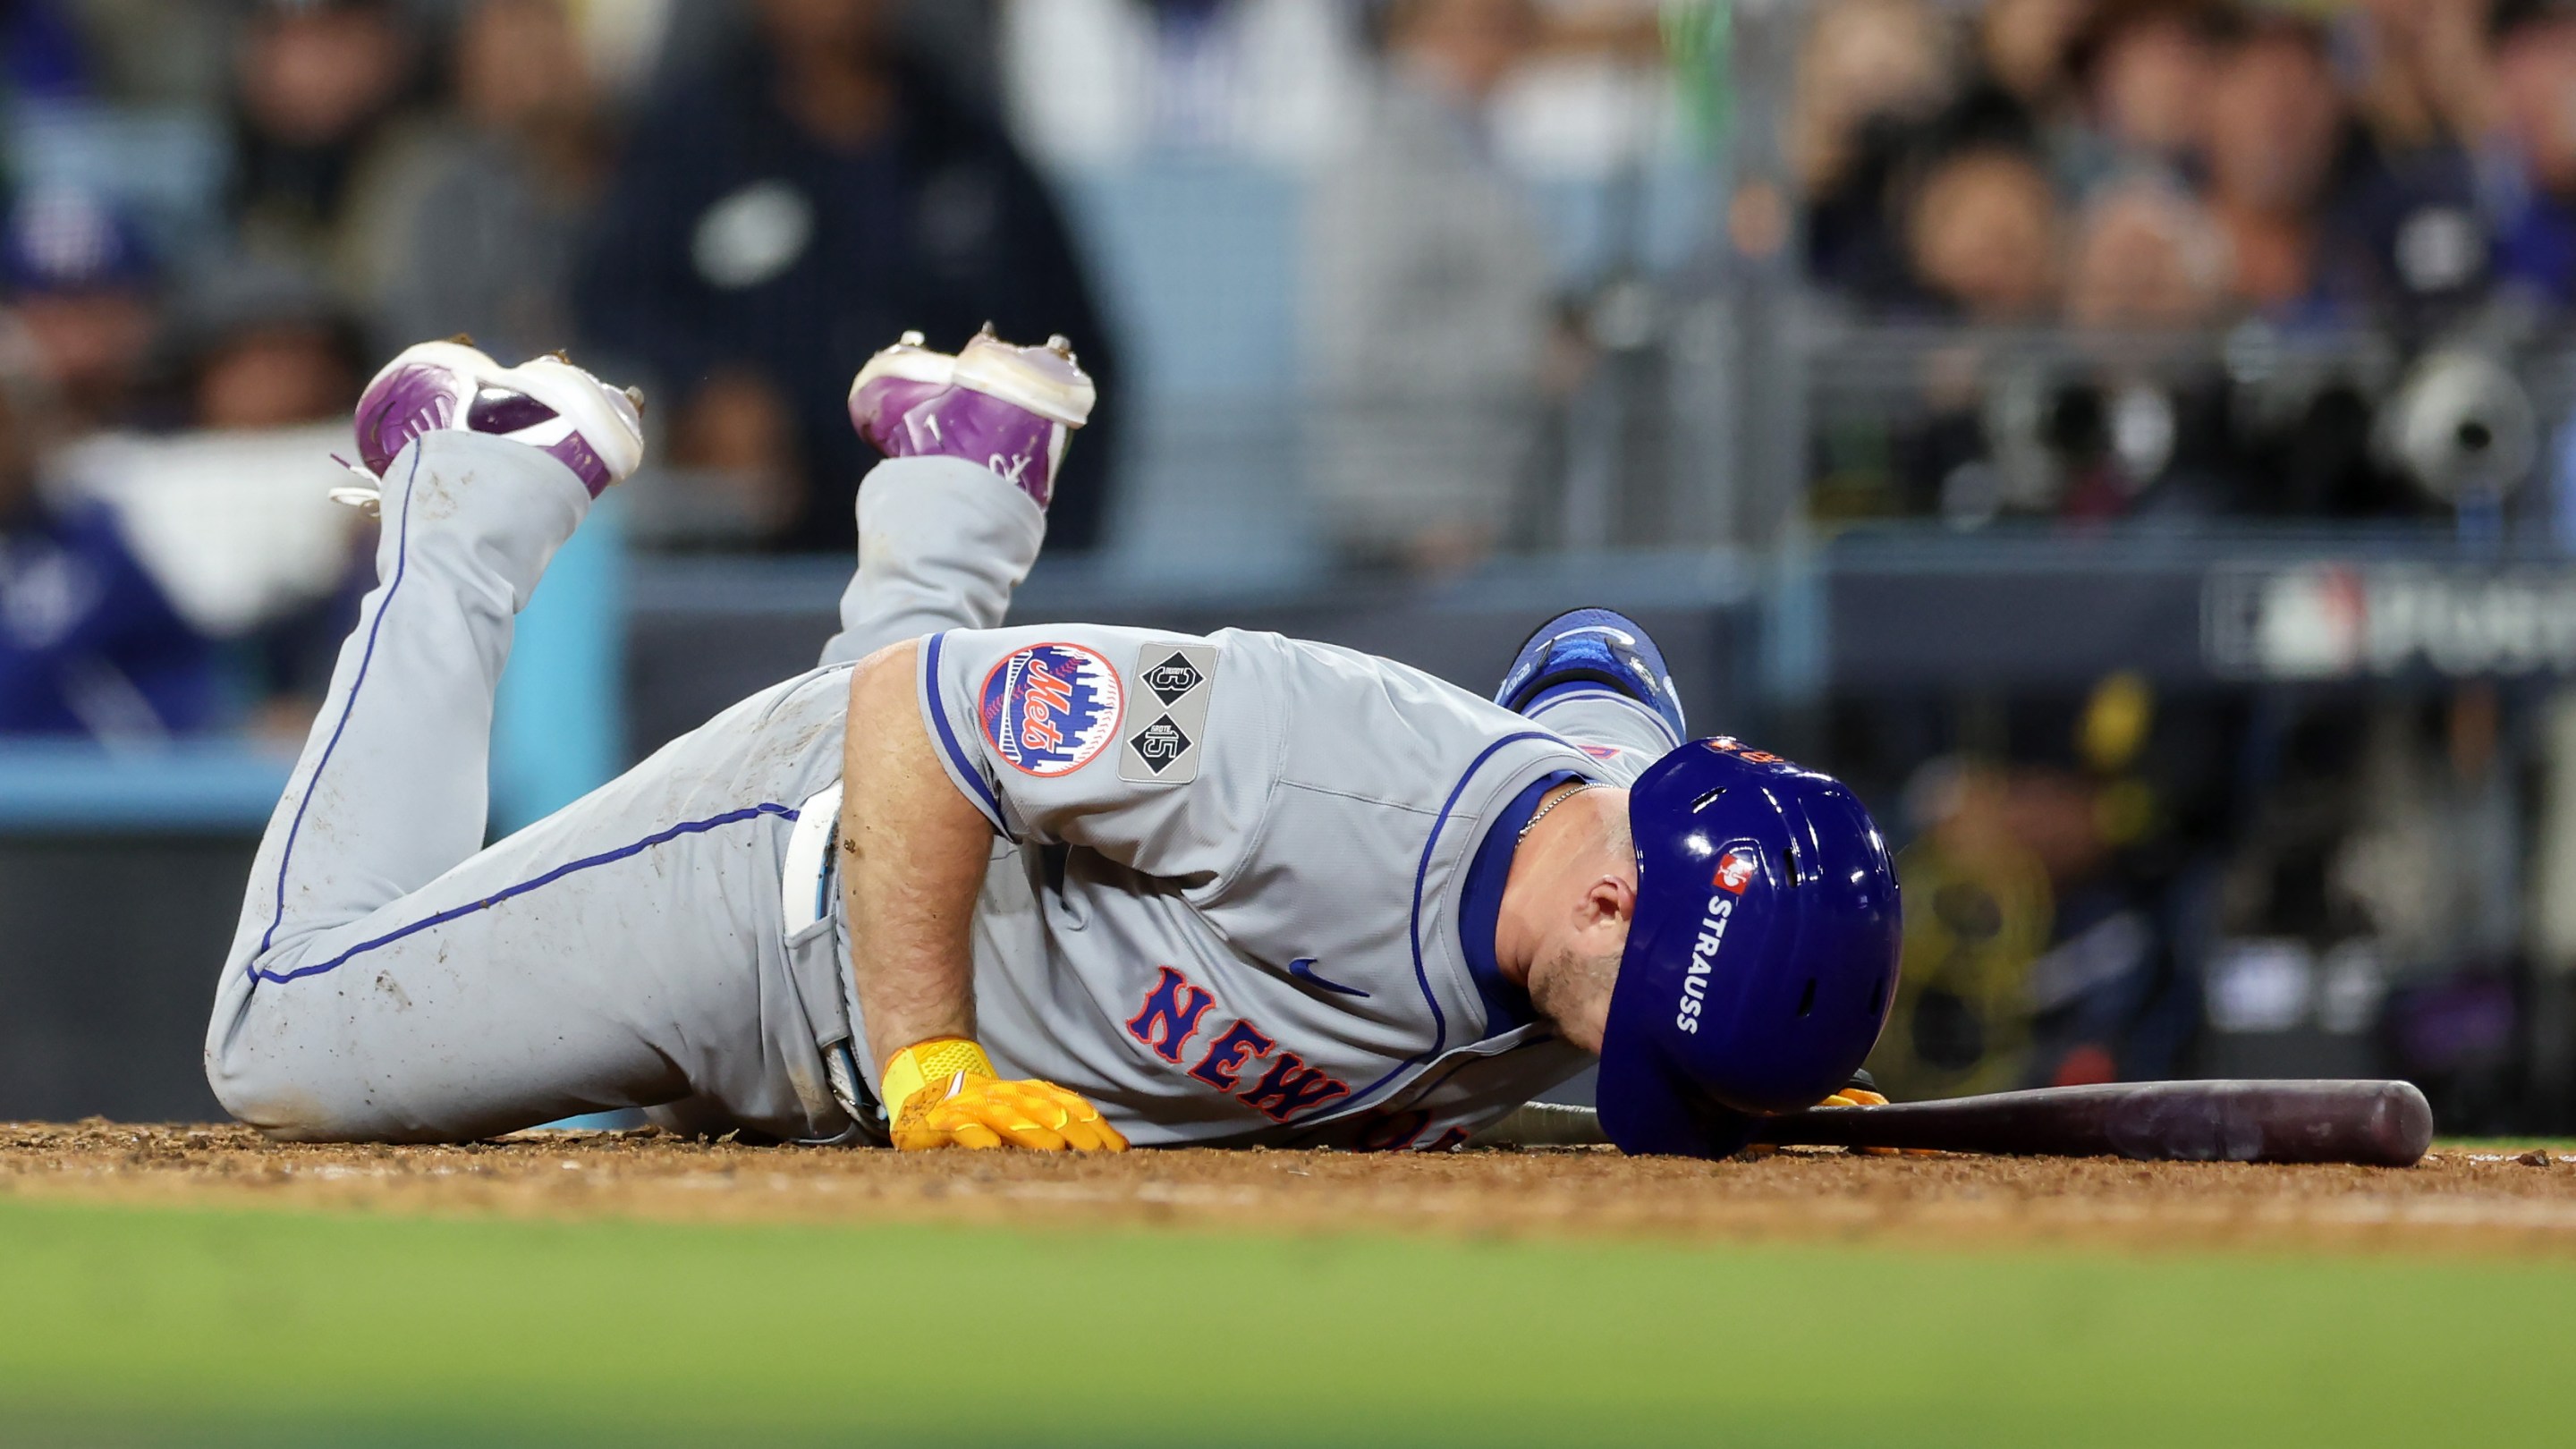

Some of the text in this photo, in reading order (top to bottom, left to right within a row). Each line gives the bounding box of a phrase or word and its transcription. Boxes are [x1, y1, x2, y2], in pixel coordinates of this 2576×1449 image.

[1021, 658, 1073, 753] Mets
[1149, 665, 1196, 691] 3
[1143, 730, 1179, 758] 15
[1676, 894, 1733, 1035] STRAUSS
[1125, 965, 1352, 1123] NEW
